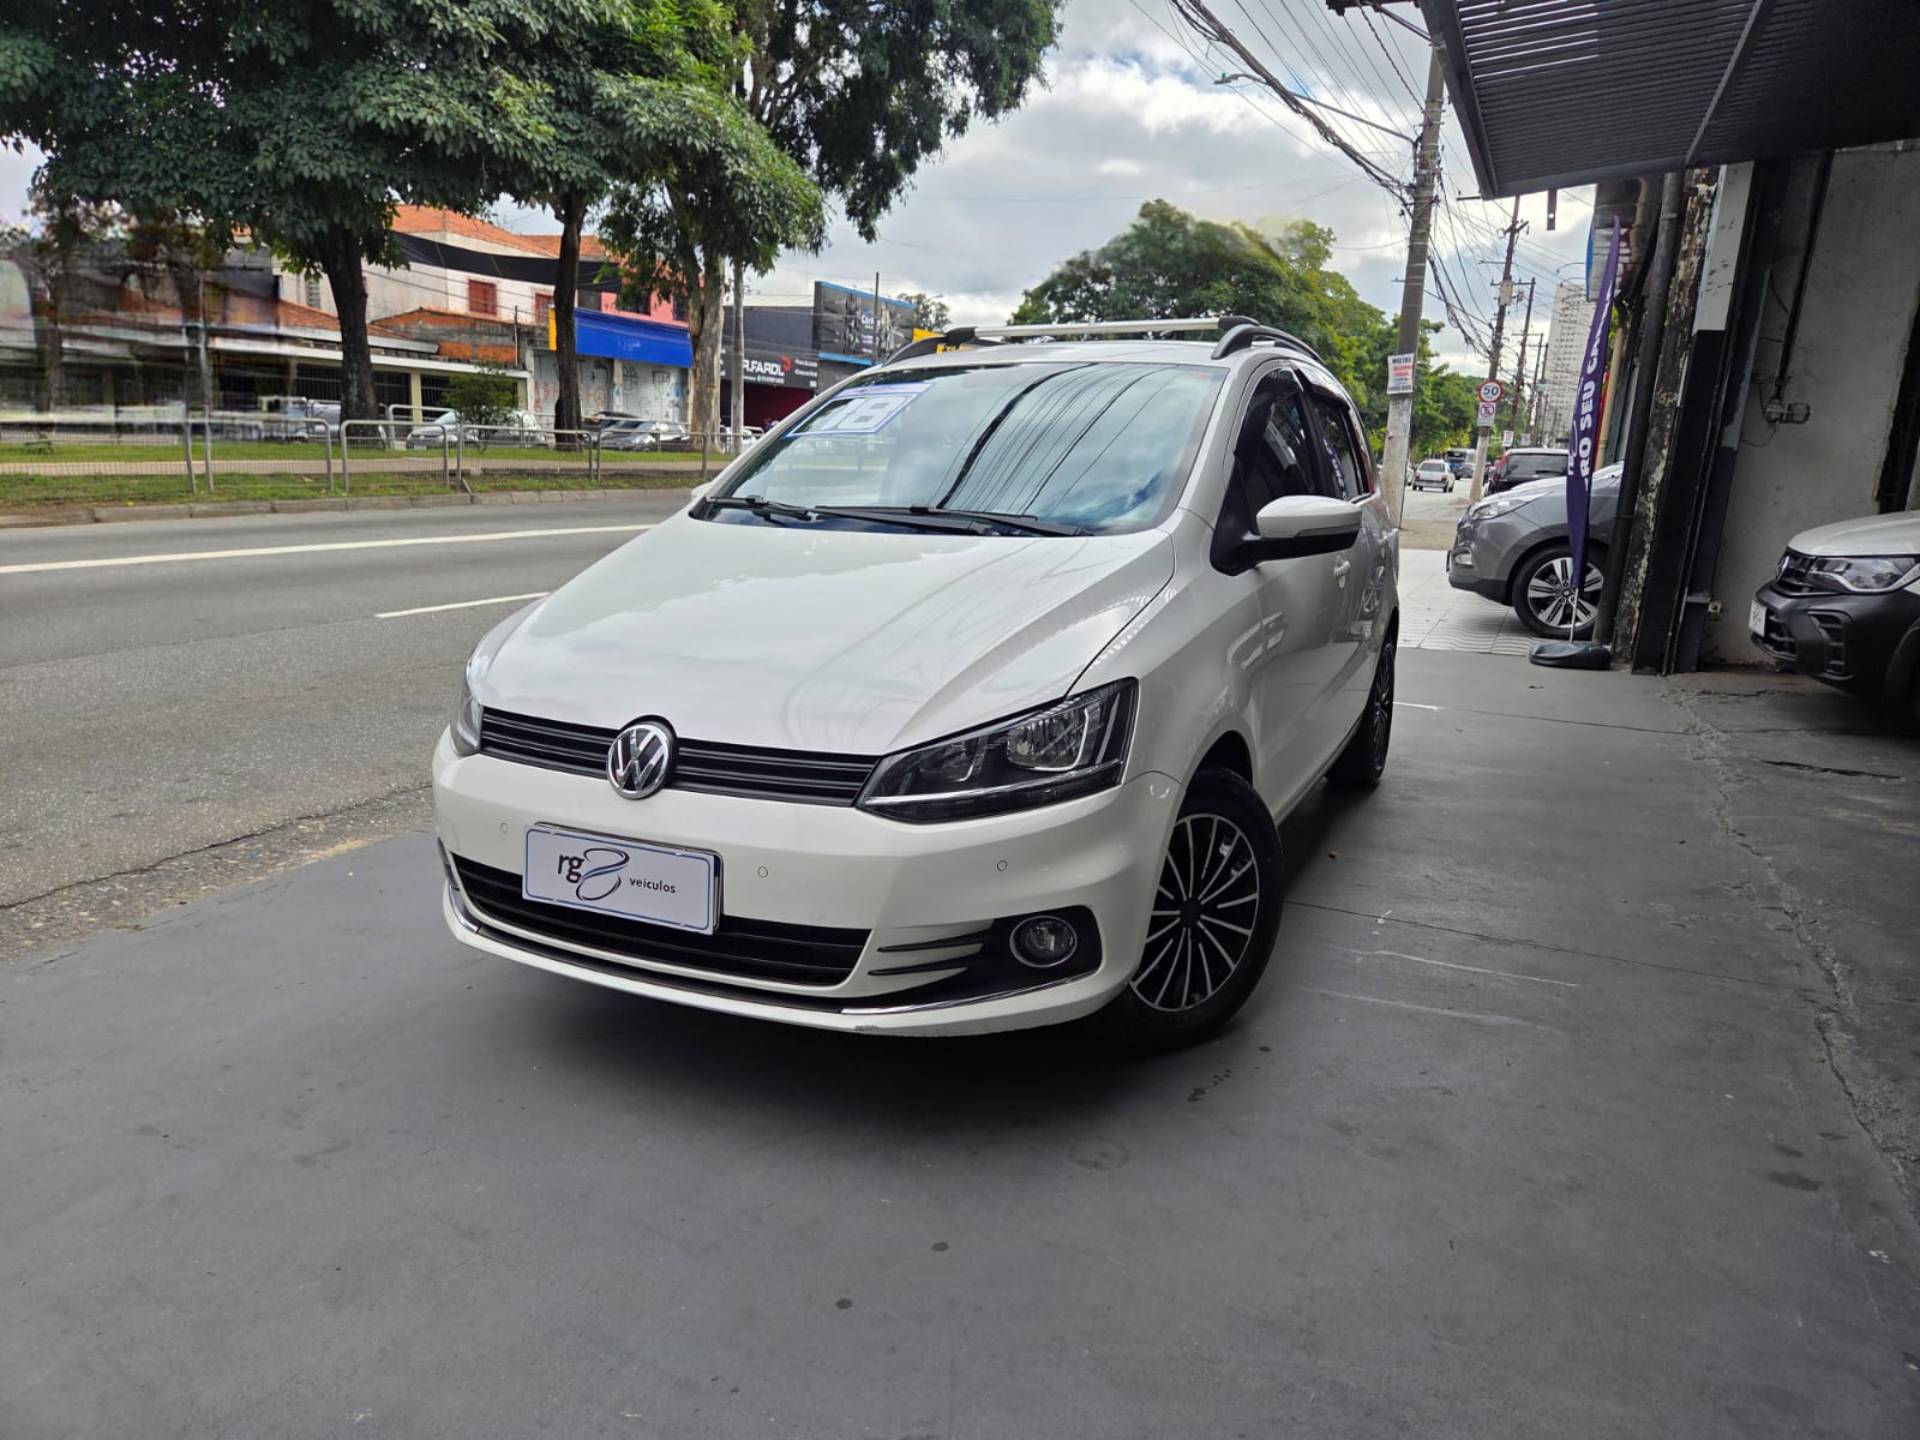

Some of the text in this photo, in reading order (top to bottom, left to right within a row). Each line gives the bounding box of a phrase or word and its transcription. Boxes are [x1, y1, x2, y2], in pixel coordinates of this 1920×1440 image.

[1483, 386, 1499, 396] 50
[1580, 380, 1596, 431] SEU
[1579, 437, 1592, 491] RO
